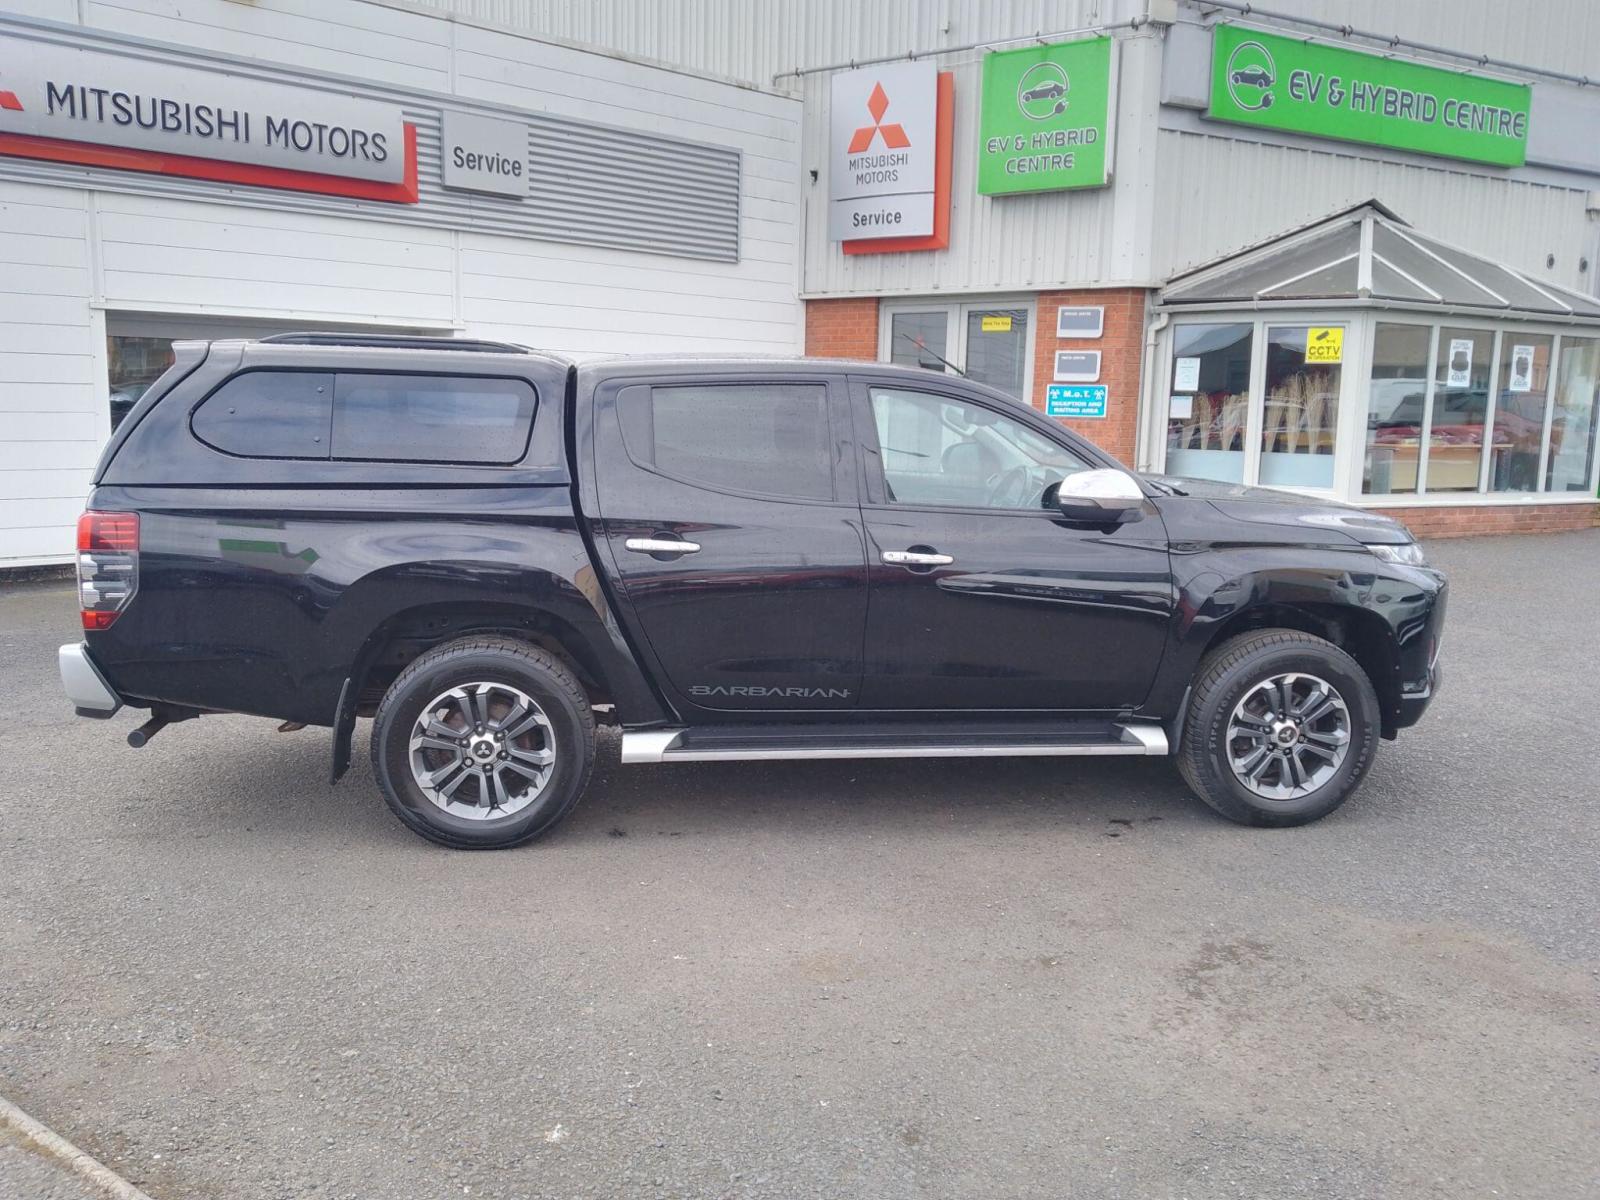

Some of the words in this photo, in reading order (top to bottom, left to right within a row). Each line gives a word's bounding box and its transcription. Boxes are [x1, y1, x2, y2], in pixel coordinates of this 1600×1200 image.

[1288, 70, 1324, 103] EV
[1328, 77, 1345, 107] &
[1350, 80, 1437, 123] HYBRID
[1443, 98, 1526, 139] CENTRE
[46, 81, 250, 144] MITSUBISHI
[266, 115, 388, 162] MOTORS
[986, 136, 1010, 154] EV
[1014, 133, 1026, 151] &
[1031, 127, 1098, 149] HYBRID
[453, 146, 522, 178] Service
[849, 153, 908, 171] MITSUBISHI
[1005, 153, 1075, 174] CENTRE
[856, 169, 899, 185] MOTORS
[852, 208, 902, 228] Service
[1309, 346, 1340, 355] CCTV
[689, 685, 850, 698] BARBARIAN
[1346, 725, 1374, 785] Fireston
